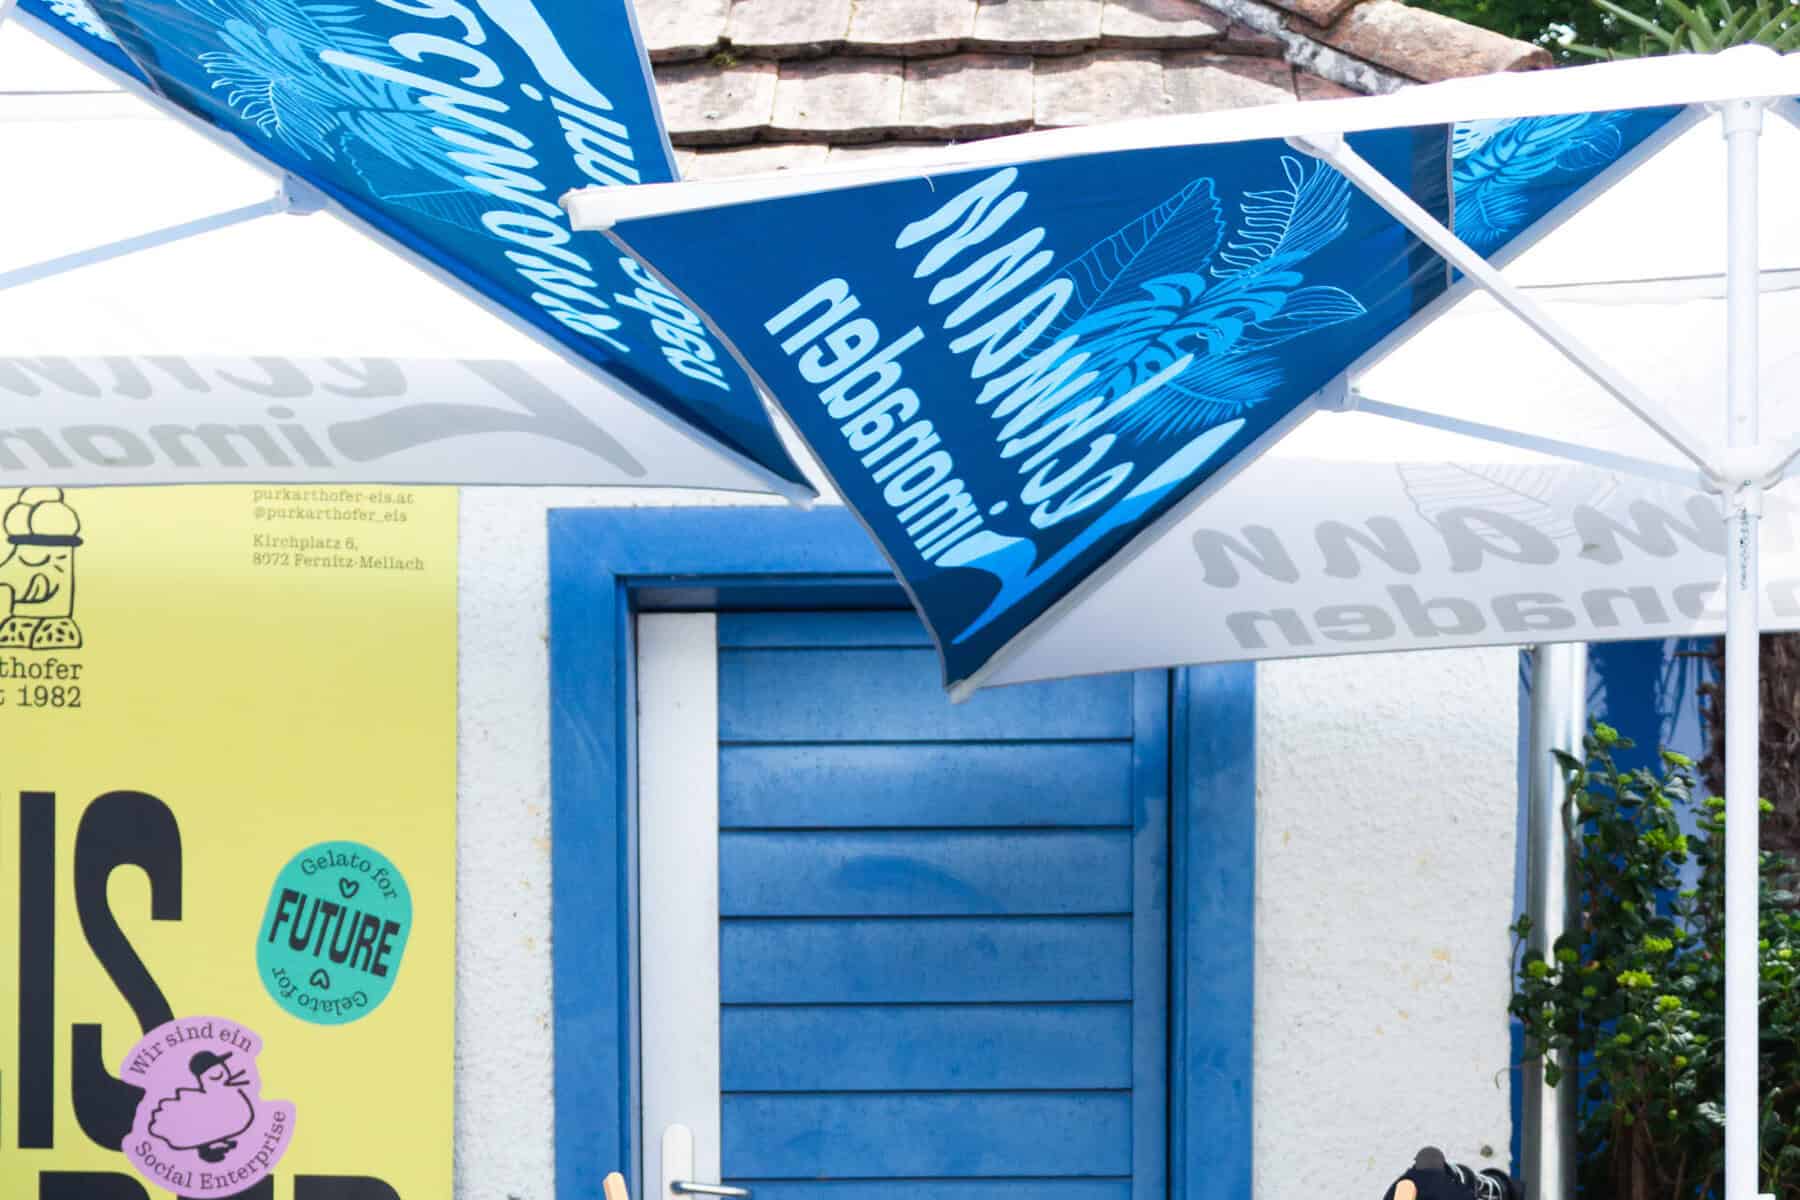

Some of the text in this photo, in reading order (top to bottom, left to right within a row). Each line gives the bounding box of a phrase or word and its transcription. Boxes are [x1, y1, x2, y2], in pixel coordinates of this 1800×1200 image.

[253, 533, 341, 551] Kirchplatz
[294, 553, 425, 571] Fernitz-Mellach
[16, 684, 81, 708] 1982
[300, 849, 398, 900] Gelato for
[268, 887, 400, 977] FUTURE
[272, 967, 368, 1016] Gelato for
[130, 1023, 253, 1076] Wir sind ein
[135, 1110, 287, 1190] Social Enterprise
